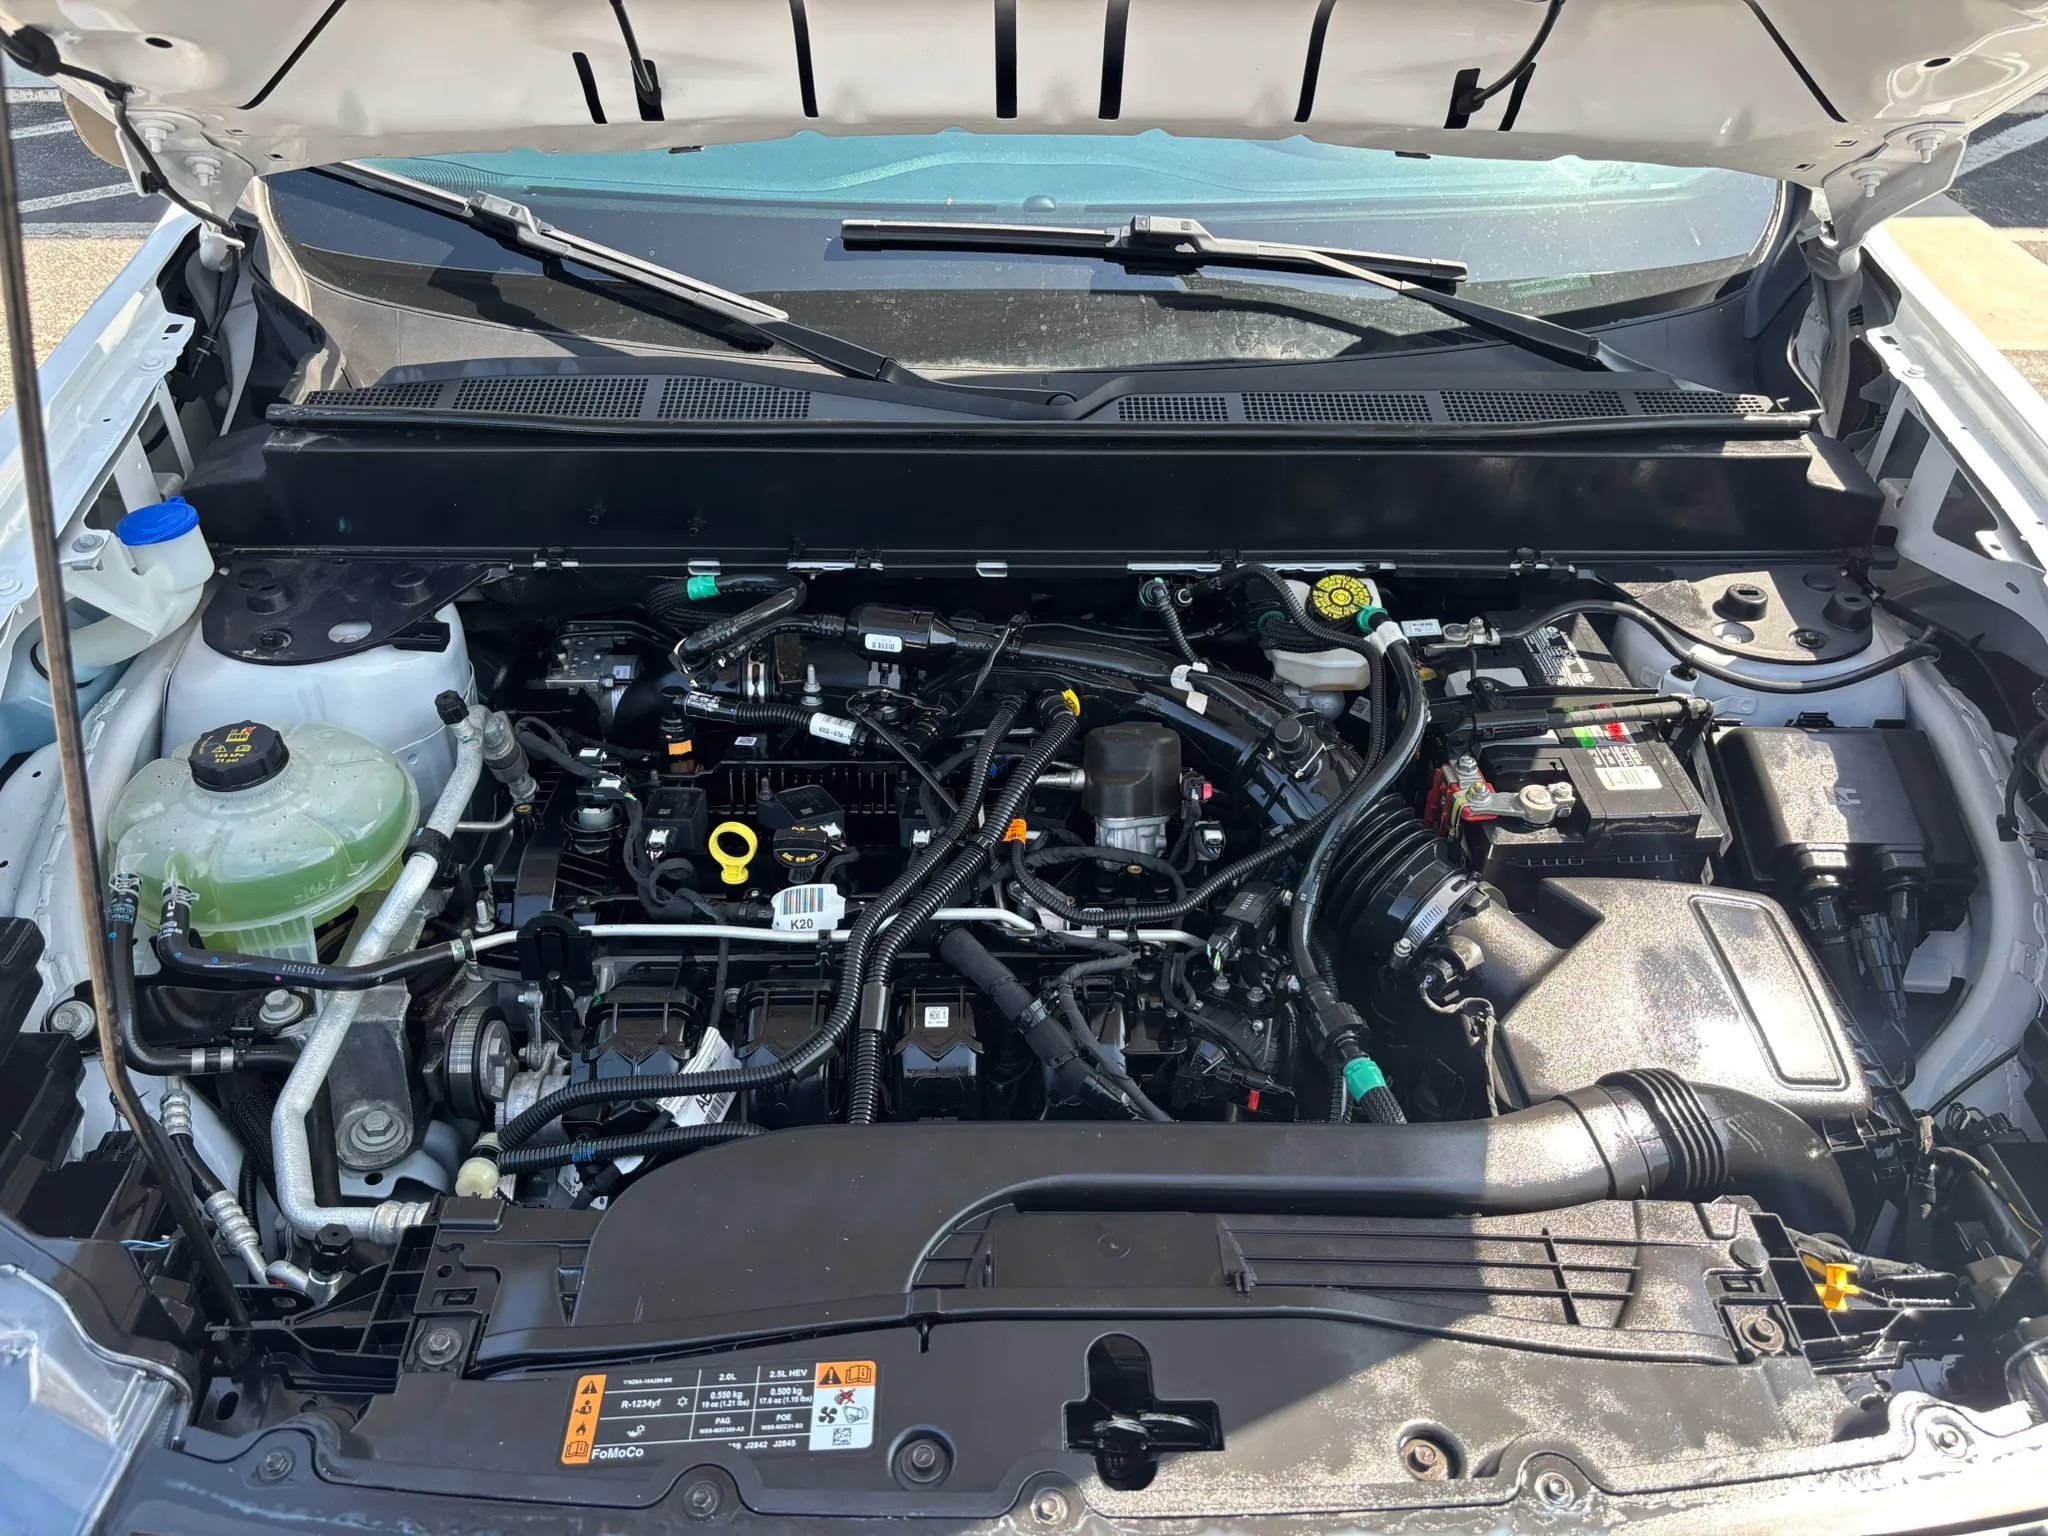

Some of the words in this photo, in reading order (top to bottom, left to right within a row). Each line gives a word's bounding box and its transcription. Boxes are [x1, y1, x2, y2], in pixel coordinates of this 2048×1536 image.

[790, 918, 814, 930] K20
[718, 1373, 737, 1381] 2.0L
[769, 1370, 787, 1378] 2.5L
[789, 1369, 808, 1377] HEV
[710, 1391, 731, 1400] 0.550
[732, 1390, 743, 1399] kg
[770, 1387, 791, 1396] 0.500
[792, 1386, 803, 1396] kg
[621, 1398, 662, 1409] R-1234yf
[776, 1413, 792, 1421] POE
[591, 1446, 644, 1460] FoMoCo
